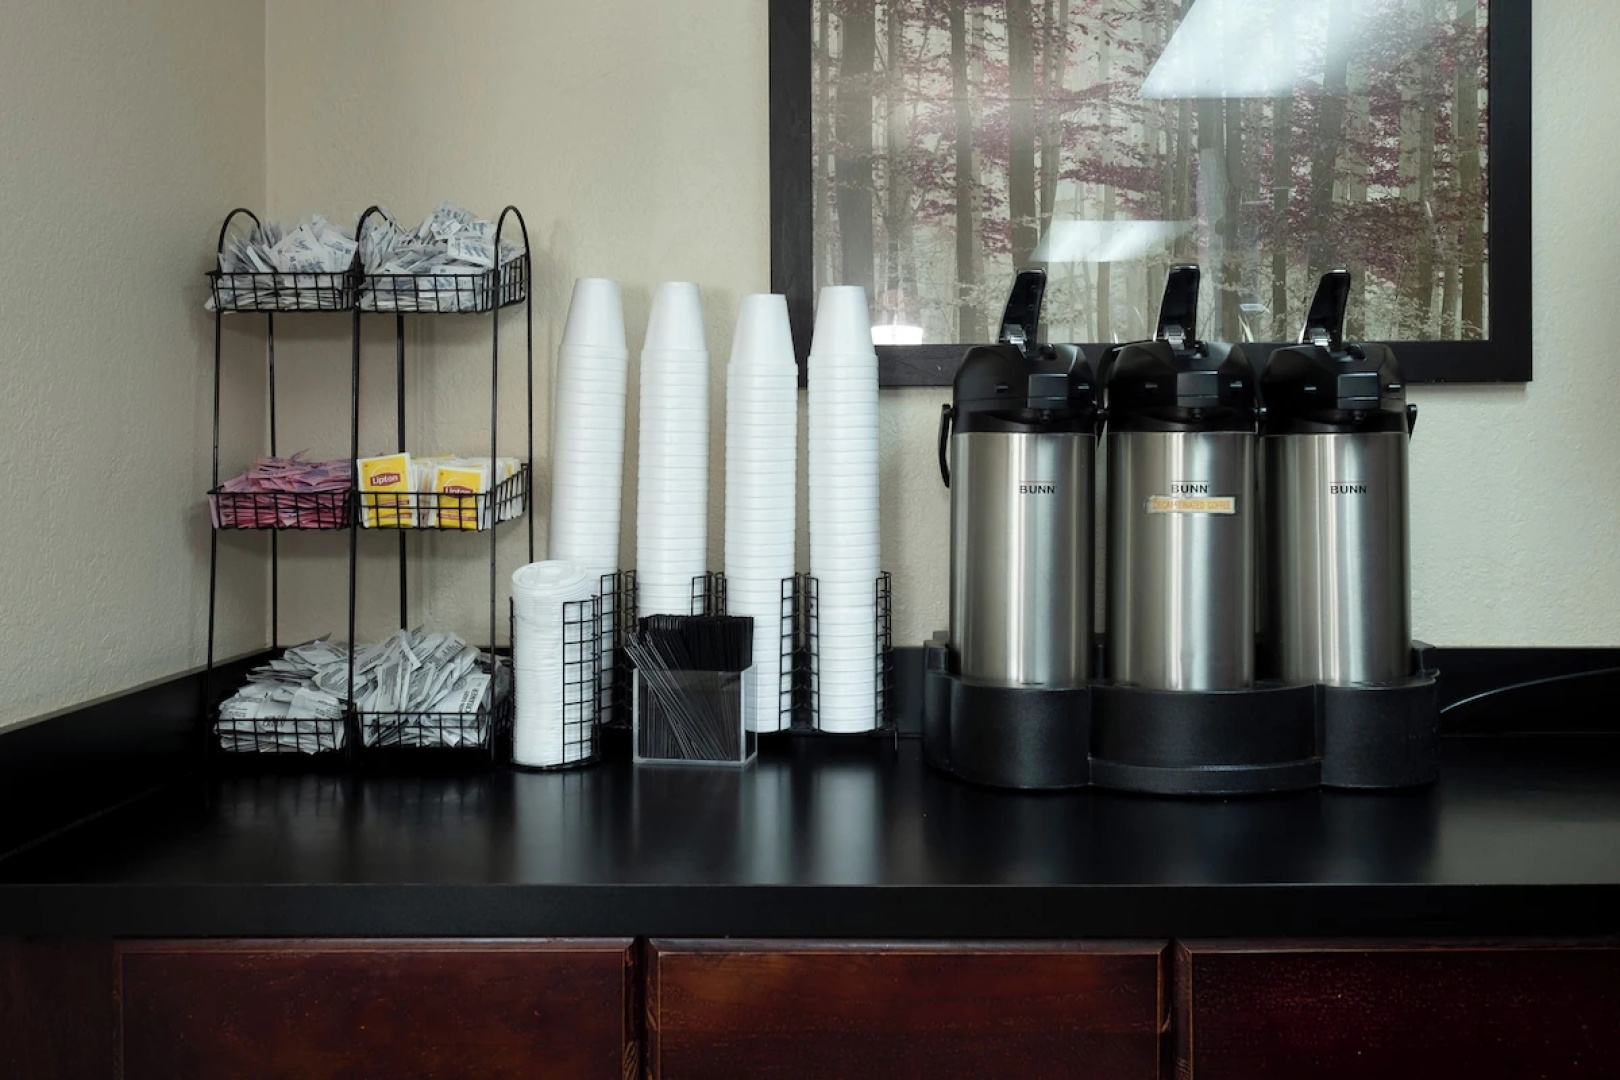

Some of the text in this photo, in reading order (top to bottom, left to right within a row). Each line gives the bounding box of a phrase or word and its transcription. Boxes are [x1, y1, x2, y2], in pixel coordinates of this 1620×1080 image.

[372, 475, 398, 485] Lipton
[1020, 485, 1055, 495] BUNN
[1171, 485, 1208, 494] BUNN
[1330, 485, 1367, 495] BUNN
